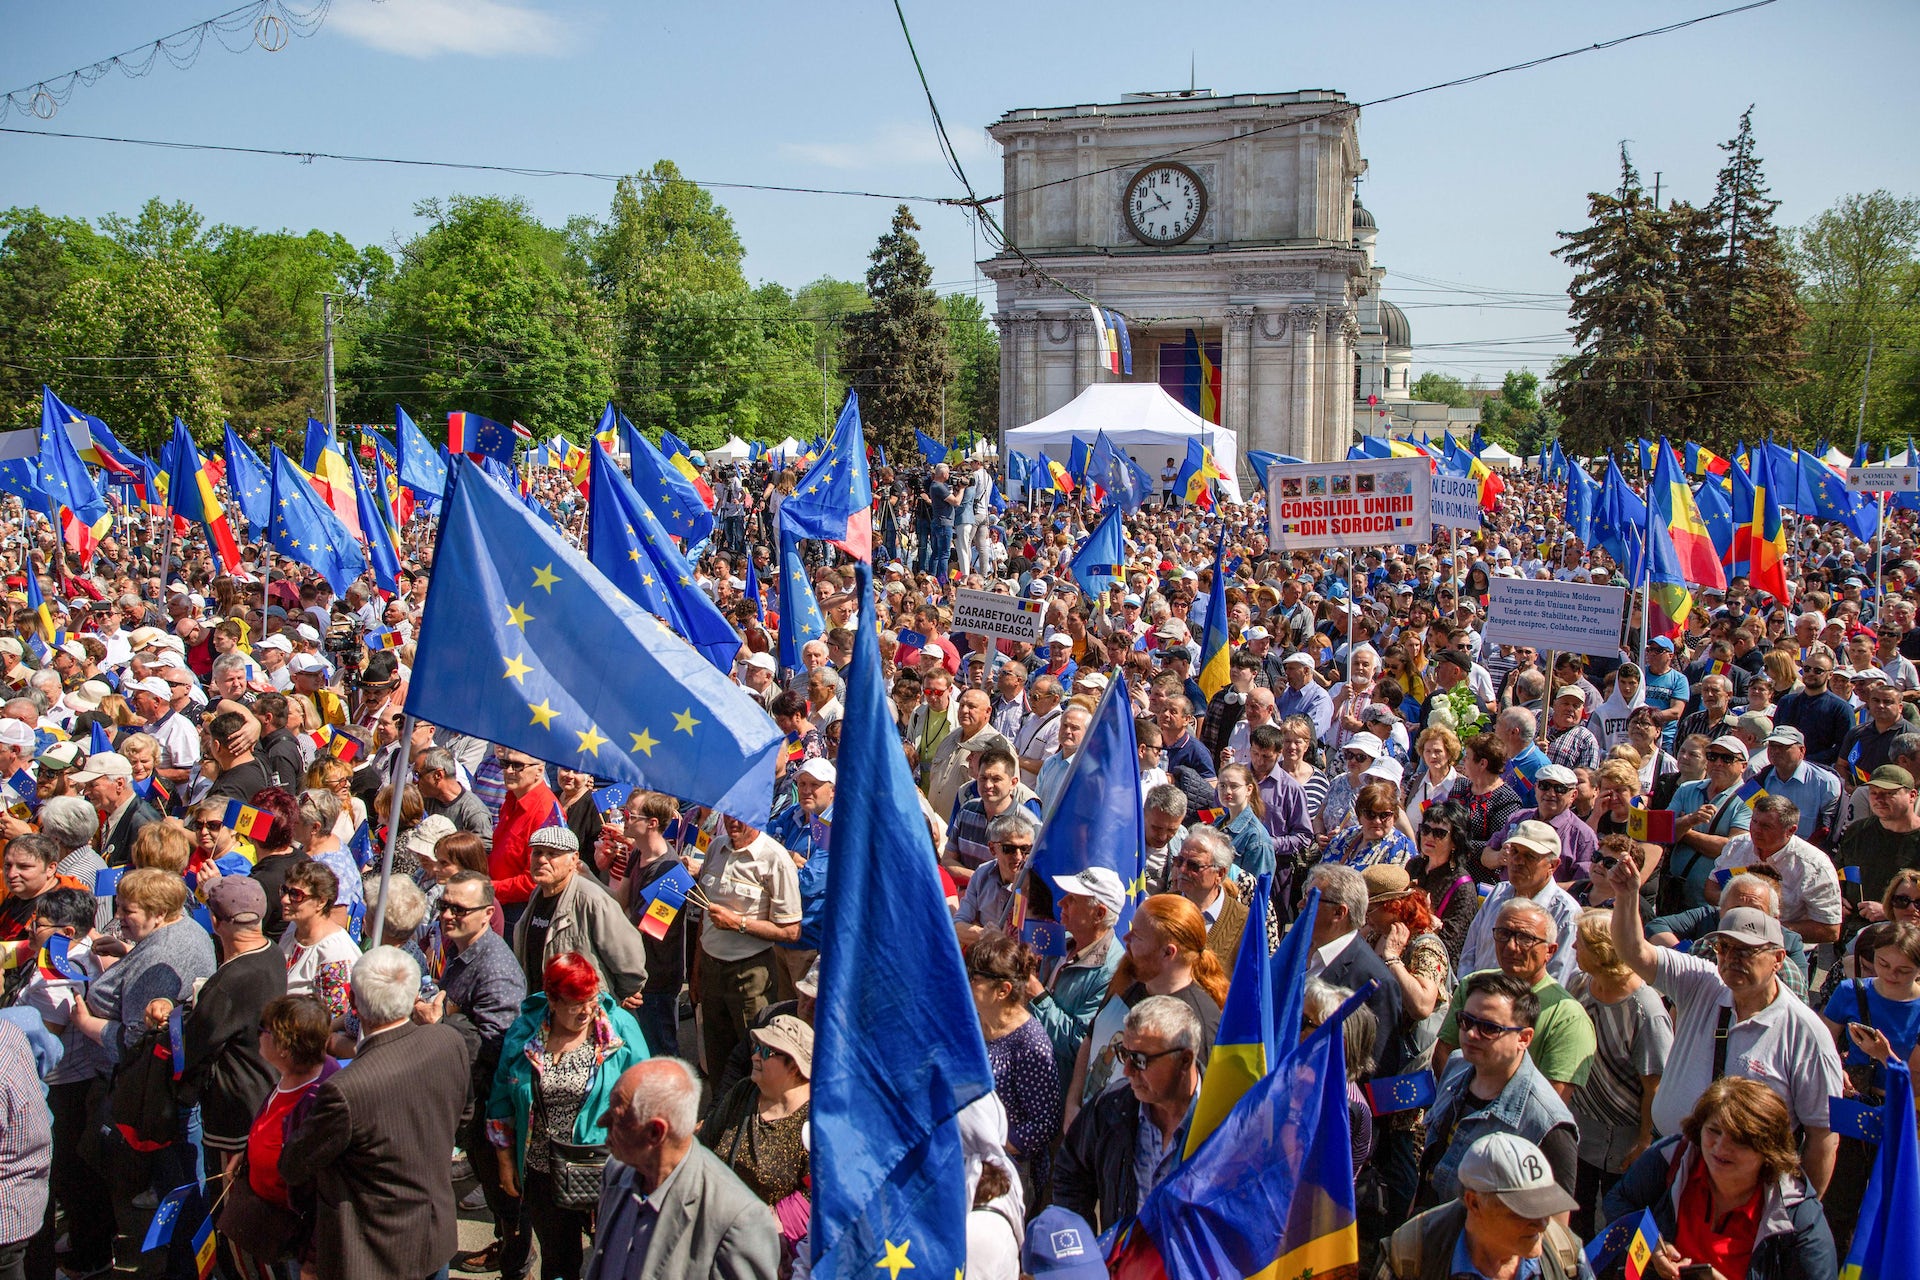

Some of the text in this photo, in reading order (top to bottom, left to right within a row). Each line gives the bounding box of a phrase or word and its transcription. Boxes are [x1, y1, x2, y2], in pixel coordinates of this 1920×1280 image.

[1148, 177, 1155, 188] 11
[1161, 173, 1170, 184] 12
[1176, 177, 1179, 188] 1
[1139, 188, 1147, 198] 10
[1184, 186, 1189, 196] 2
[1137, 200, 1141, 211] 9
[1187, 199, 1193, 209] 3
[1139, 213, 1144, 223] 8
[1184, 212, 1189, 222] 4
[1149, 223, 1154, 233] 7
[1161, 225, 1166, 235] 6
[1174, 222, 1180, 232] 5
[1441, 480, 1477, 499] EUROPA
[1281, 495, 1413, 519] CONSILIUL UNIRII
[1301, 515, 1394, 536] DIN SOROCA
[1507, 586, 1524, 594] Vrem
[1536, 589, 1570, 599] Republica
[1572, 592, 1601, 602] Moldova
[1514, 598, 1532, 607] parte
[1534, 599, 1545, 607] din
[1548, 600, 1576, 610] Uniunea
[959, 605, 1032, 626] CARABETOVCA
[1504, 607, 1521, 616] Unde
[1541, 611, 1579, 622] Stabilitate,
[1582, 615, 1600, 624] Pace,
[955, 617, 1034, 638] BASARABEASCA
[1490, 616, 1516, 626] Respect
[1518, 621, 1548, 630] reciproc,
[1550, 623, 1587, 633] Colaborare
[1523, 1155, 1543, 1182] B
